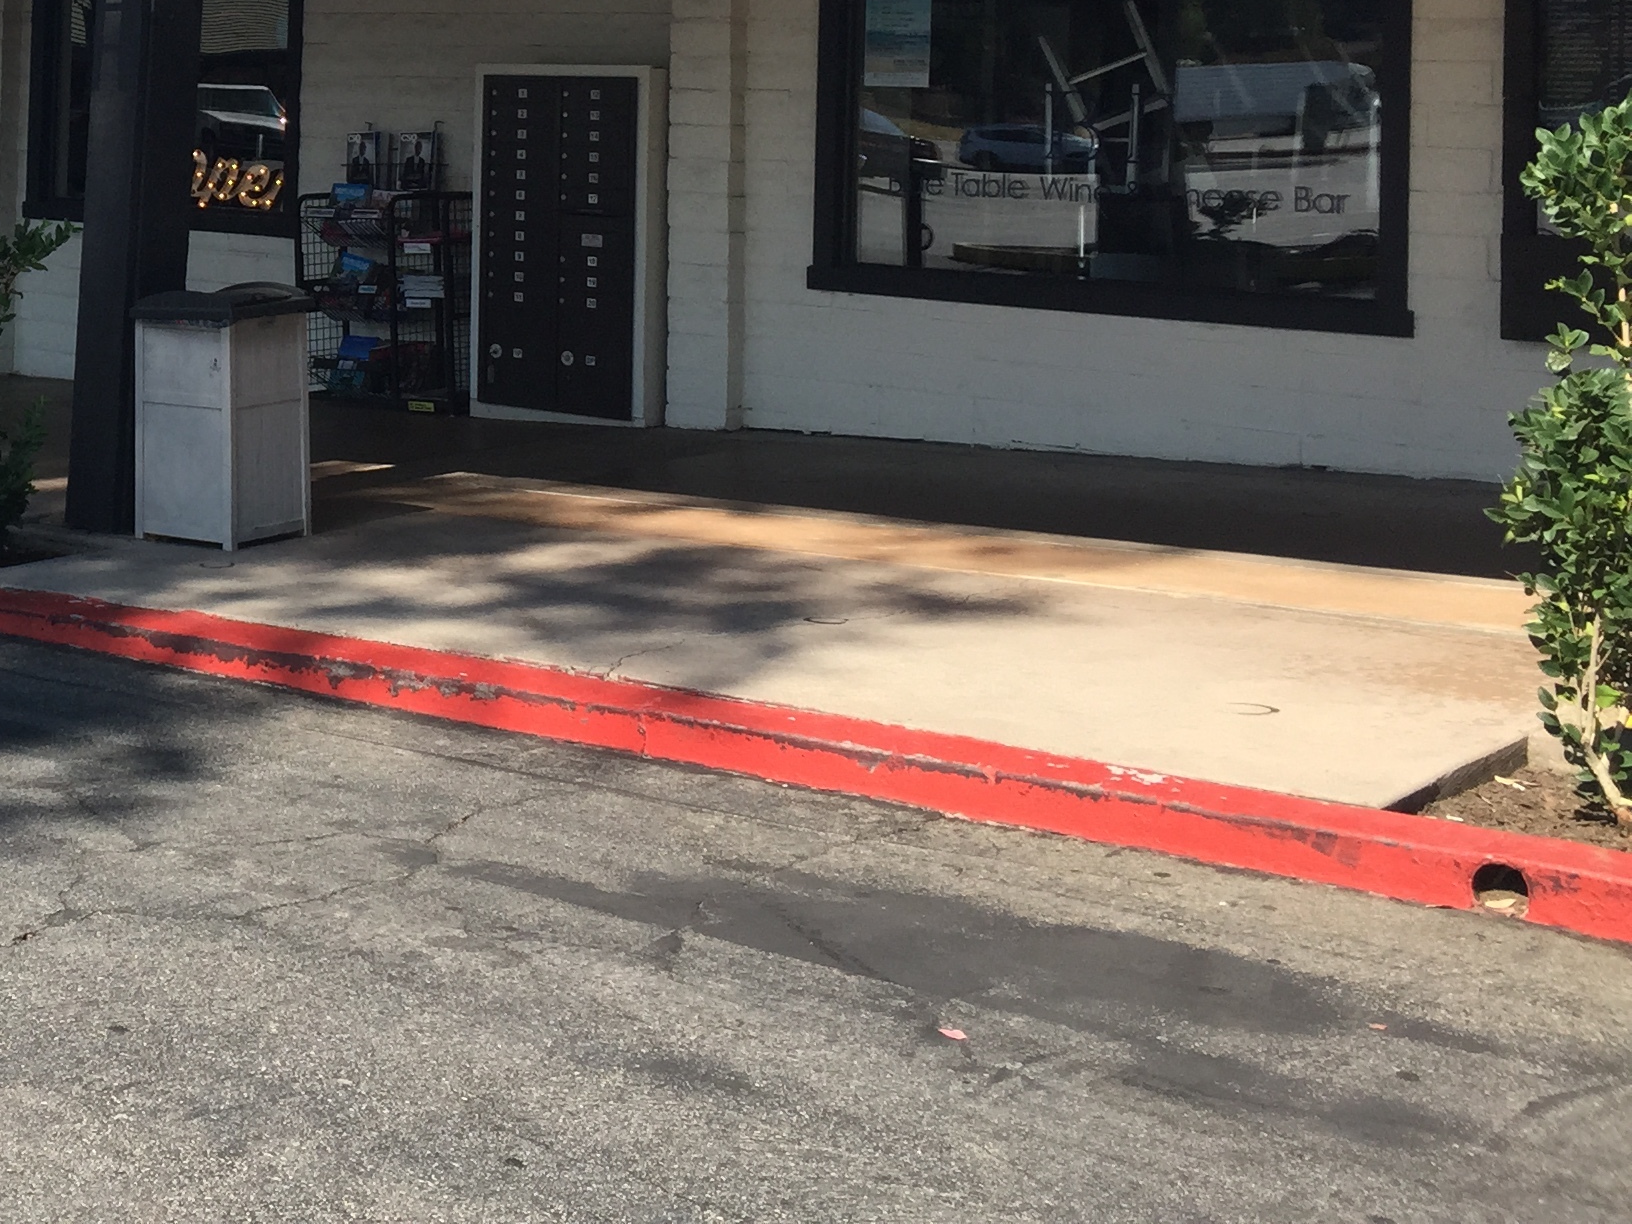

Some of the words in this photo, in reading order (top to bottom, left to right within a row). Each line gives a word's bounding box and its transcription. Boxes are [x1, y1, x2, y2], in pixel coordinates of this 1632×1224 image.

[191, 149, 284, 210] pe
[951, 172, 1030, 199] Table
[1294, 186, 1351, 214] Bar
